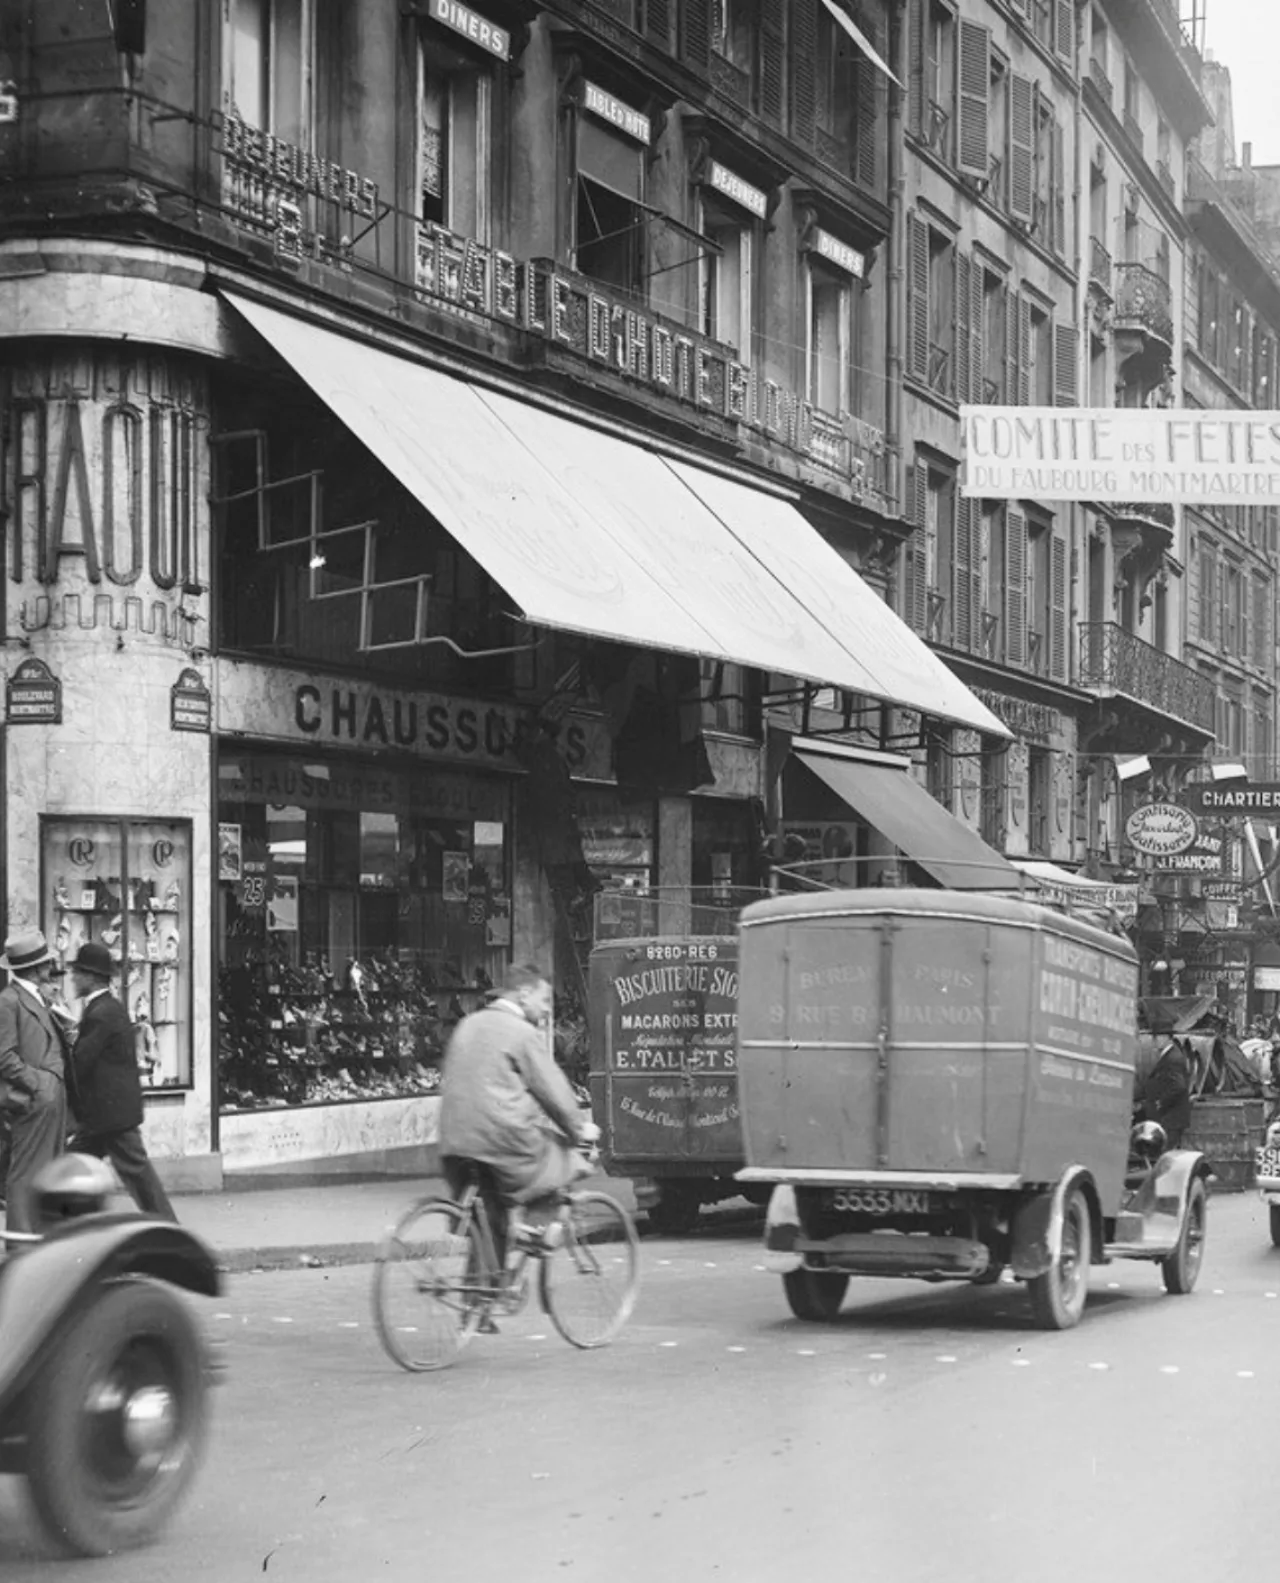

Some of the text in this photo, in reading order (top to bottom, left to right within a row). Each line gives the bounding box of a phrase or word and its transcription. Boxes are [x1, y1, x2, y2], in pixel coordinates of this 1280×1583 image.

[1121, 443, 1155, 463] DES
[975, 466, 1001, 489] DU
[1011, 467, 1118, 492] FAUBOURG
[294, 684, 587, 767] CHAUSSUS
[614, 965, 708, 1007] BISCUITERIE
[621, 1013, 699, 1030] MACARONS
